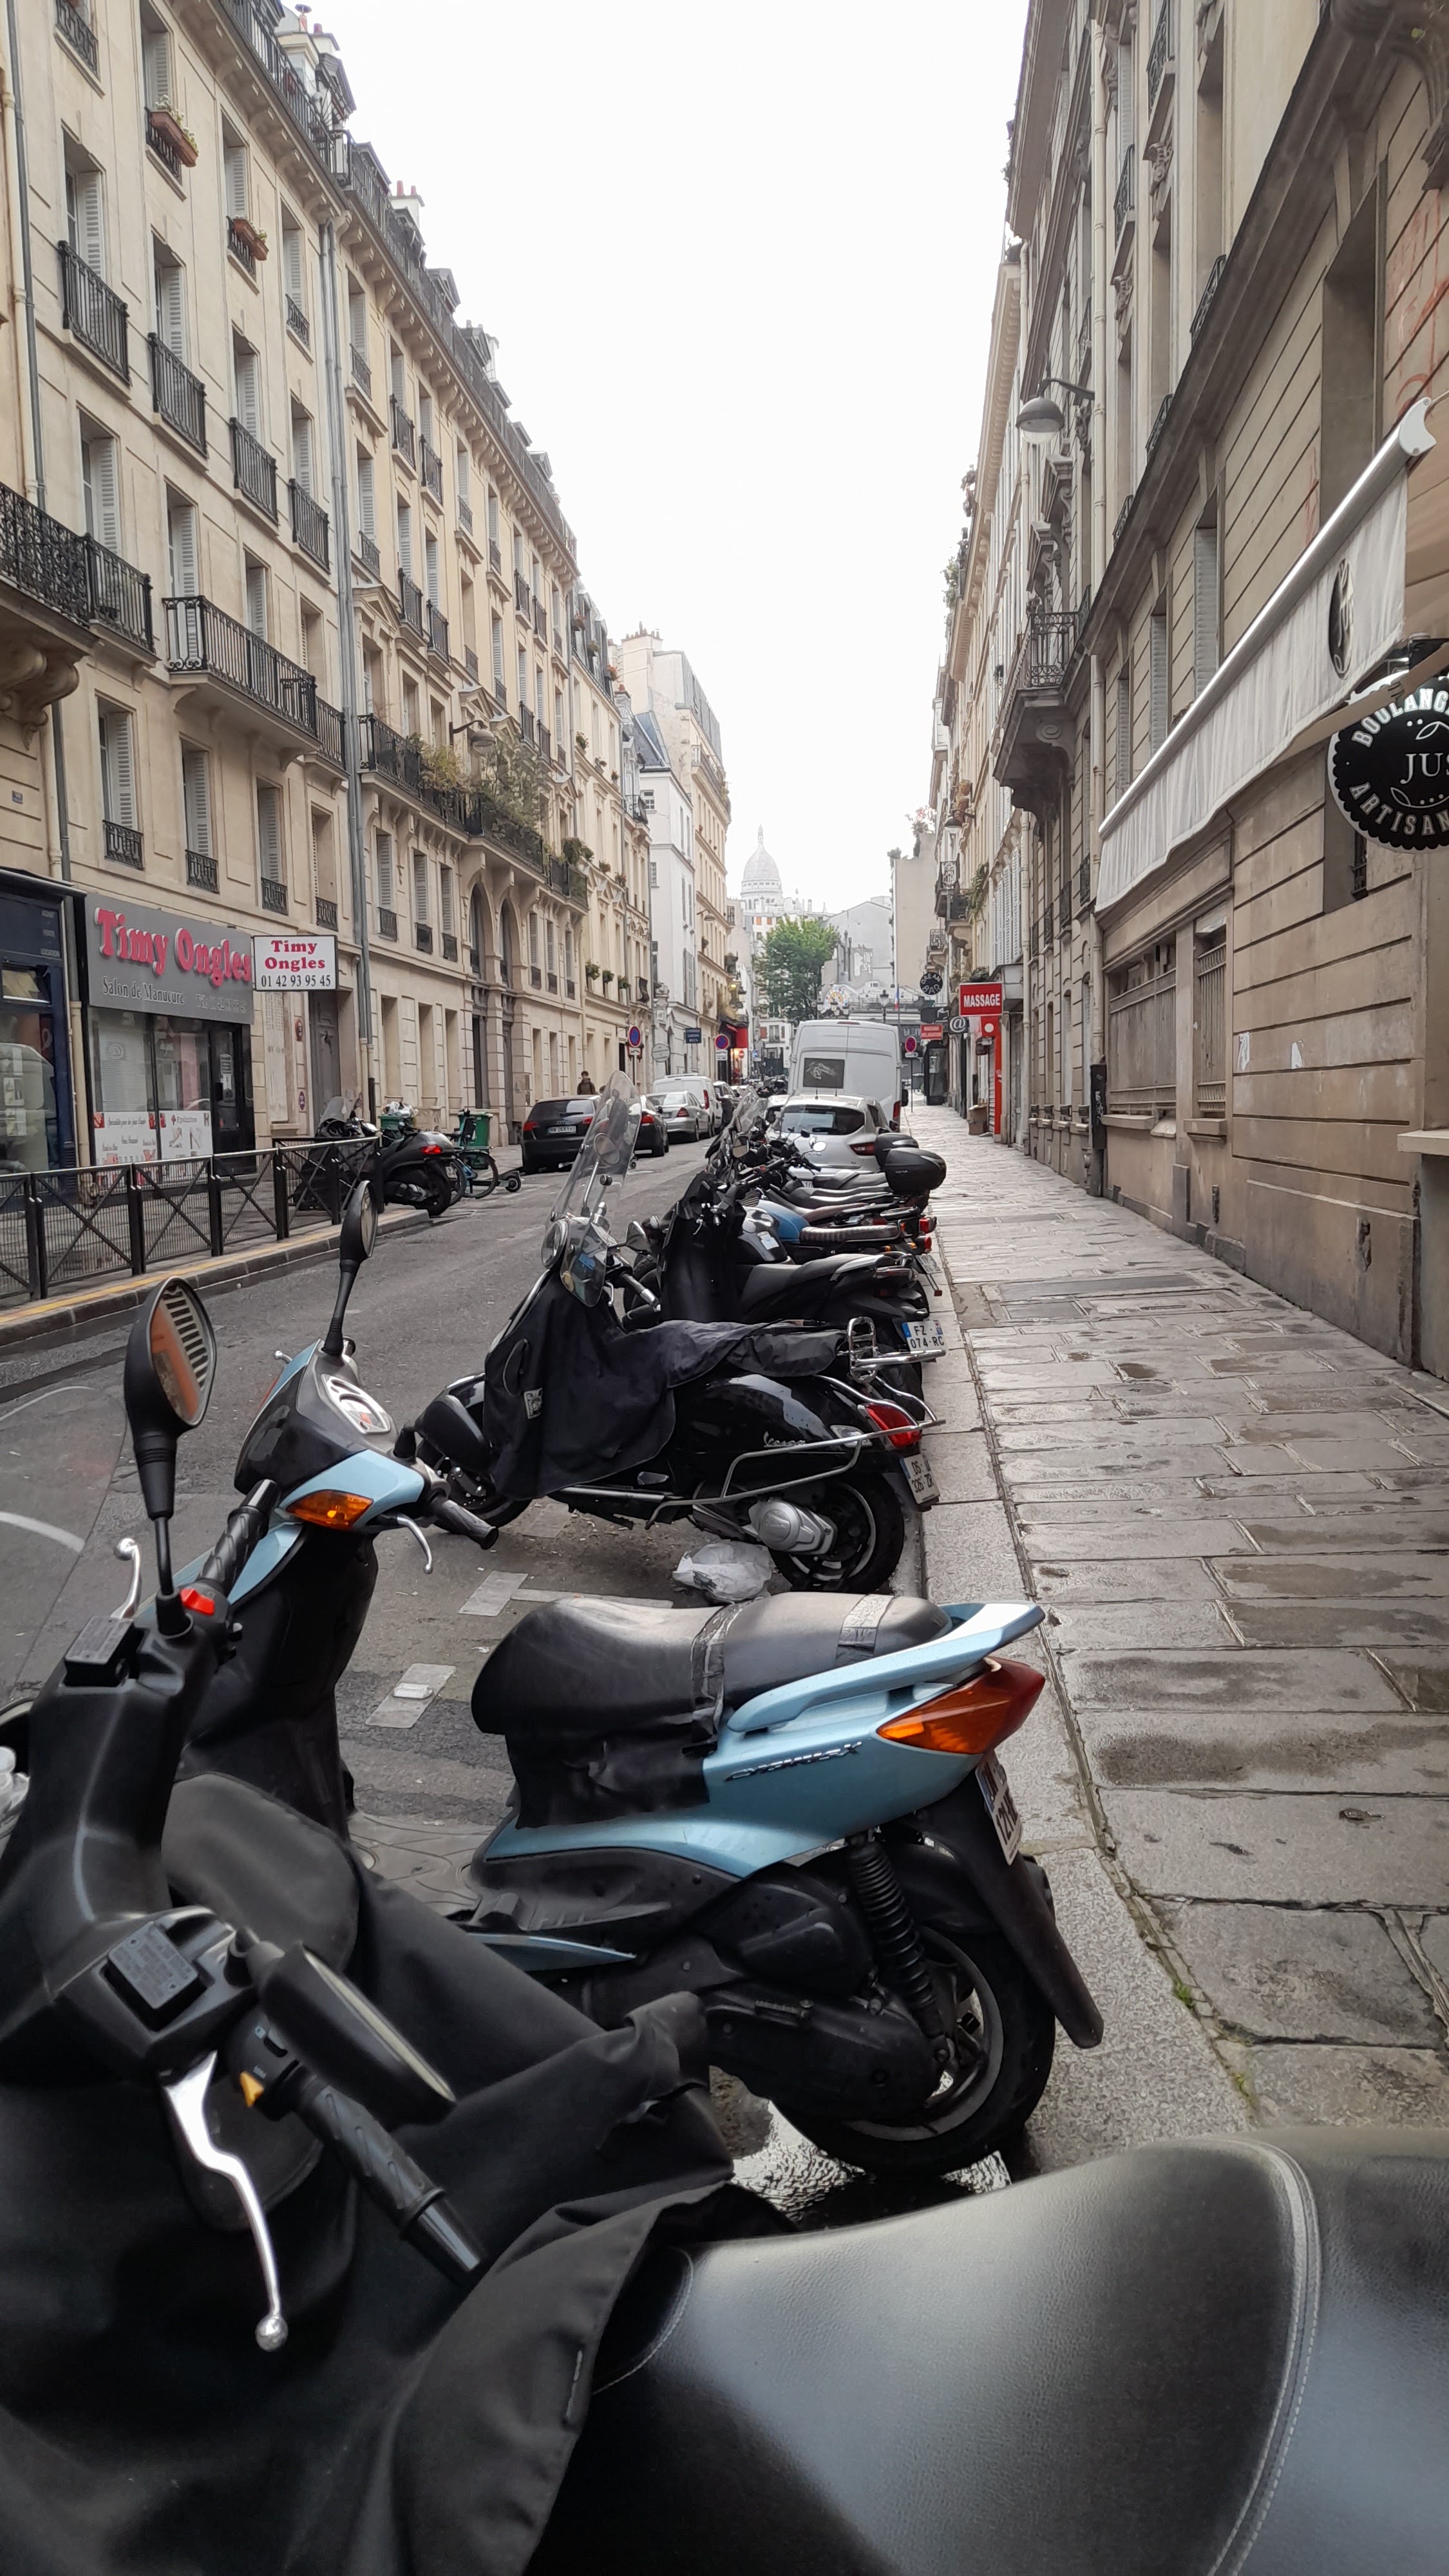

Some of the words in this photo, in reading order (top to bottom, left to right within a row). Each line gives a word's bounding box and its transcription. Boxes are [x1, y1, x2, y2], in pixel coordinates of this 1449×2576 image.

[1351, 688, 1449, 748] BOULANG
[1400, 752, 1449, 784] JU
[95, 907, 169, 976] Timy
[175, 927, 252, 987] Ongles
[270, 940, 317, 955] Timy
[265, 957, 326, 972] Ongles
[261, 974, 272, 987] 01
[276, 974, 287, 987] 42
[290, 974, 301, 987] 93
[305, 974, 316, 987] 95
[319, 974, 331, 987] 45
[921, 973, 942, 985] DREAM
[103, 976, 129, 999] Salon
[131, 981, 141, 999] de
[142, 982, 184, 1005] Manucure
[922, 984, 942, 994] BAR
[963, 994, 1000, 1007] MASSAGE
